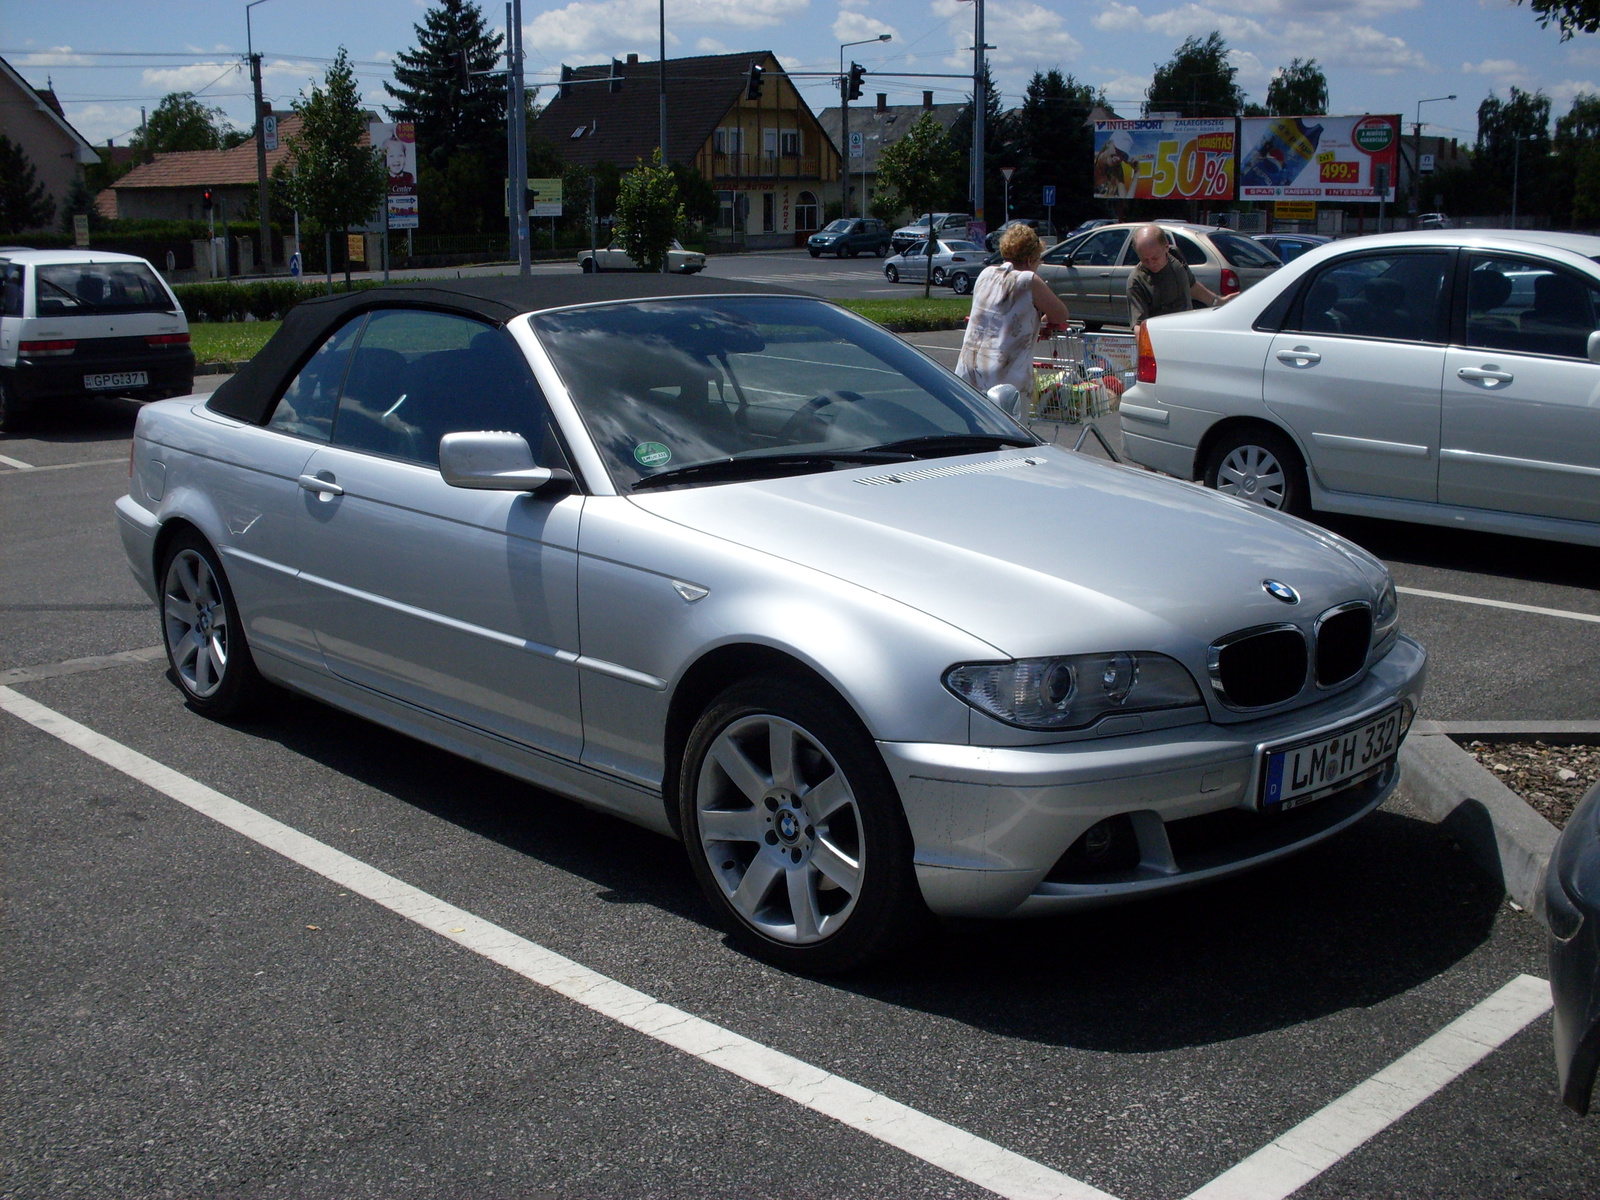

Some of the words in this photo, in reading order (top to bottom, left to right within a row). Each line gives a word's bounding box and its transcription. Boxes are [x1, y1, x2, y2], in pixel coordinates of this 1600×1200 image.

[1107, 120, 1163, 130] INTERSPORT
[1175, 119, 1224, 127] ZALAEGERSZEG
[94, 374, 120, 387] GPG
[125, 372, 146, 385] 371
[1291, 745, 1328, 791] LM
[1339, 734, 1357, 775] H
[1361, 715, 1396, 765] 332
[1270, 784, 1277, 795] D
